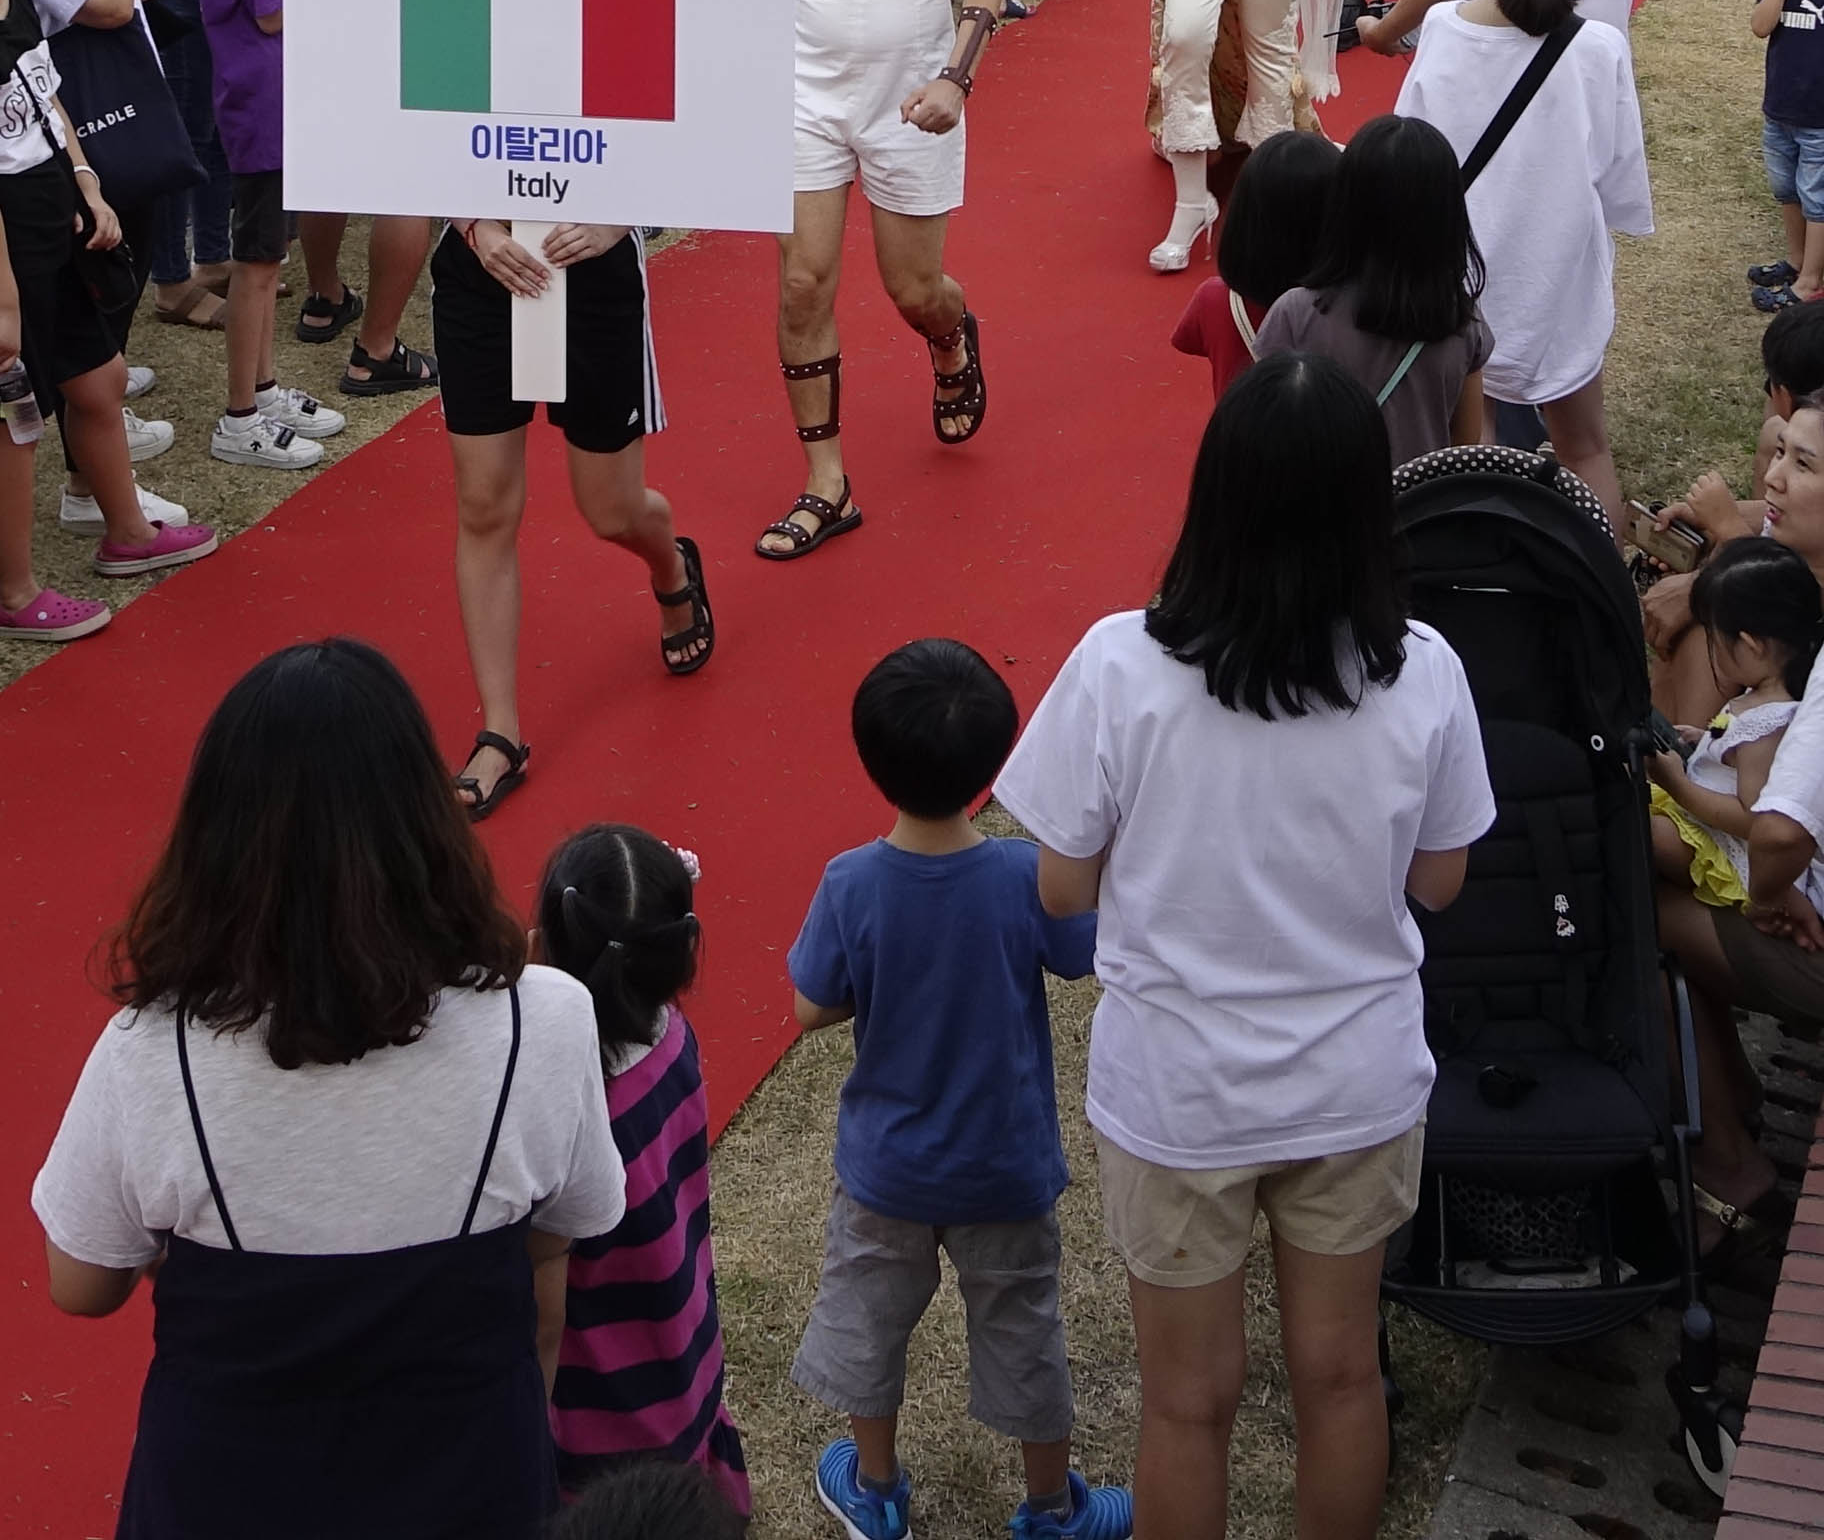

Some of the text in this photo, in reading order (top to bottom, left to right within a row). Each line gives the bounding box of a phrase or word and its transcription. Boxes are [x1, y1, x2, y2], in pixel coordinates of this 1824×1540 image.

[76, 104, 137, 139] CRADLE
[470, 124, 608, 165] 이탈리아
[507, 169, 570, 204] Italy
